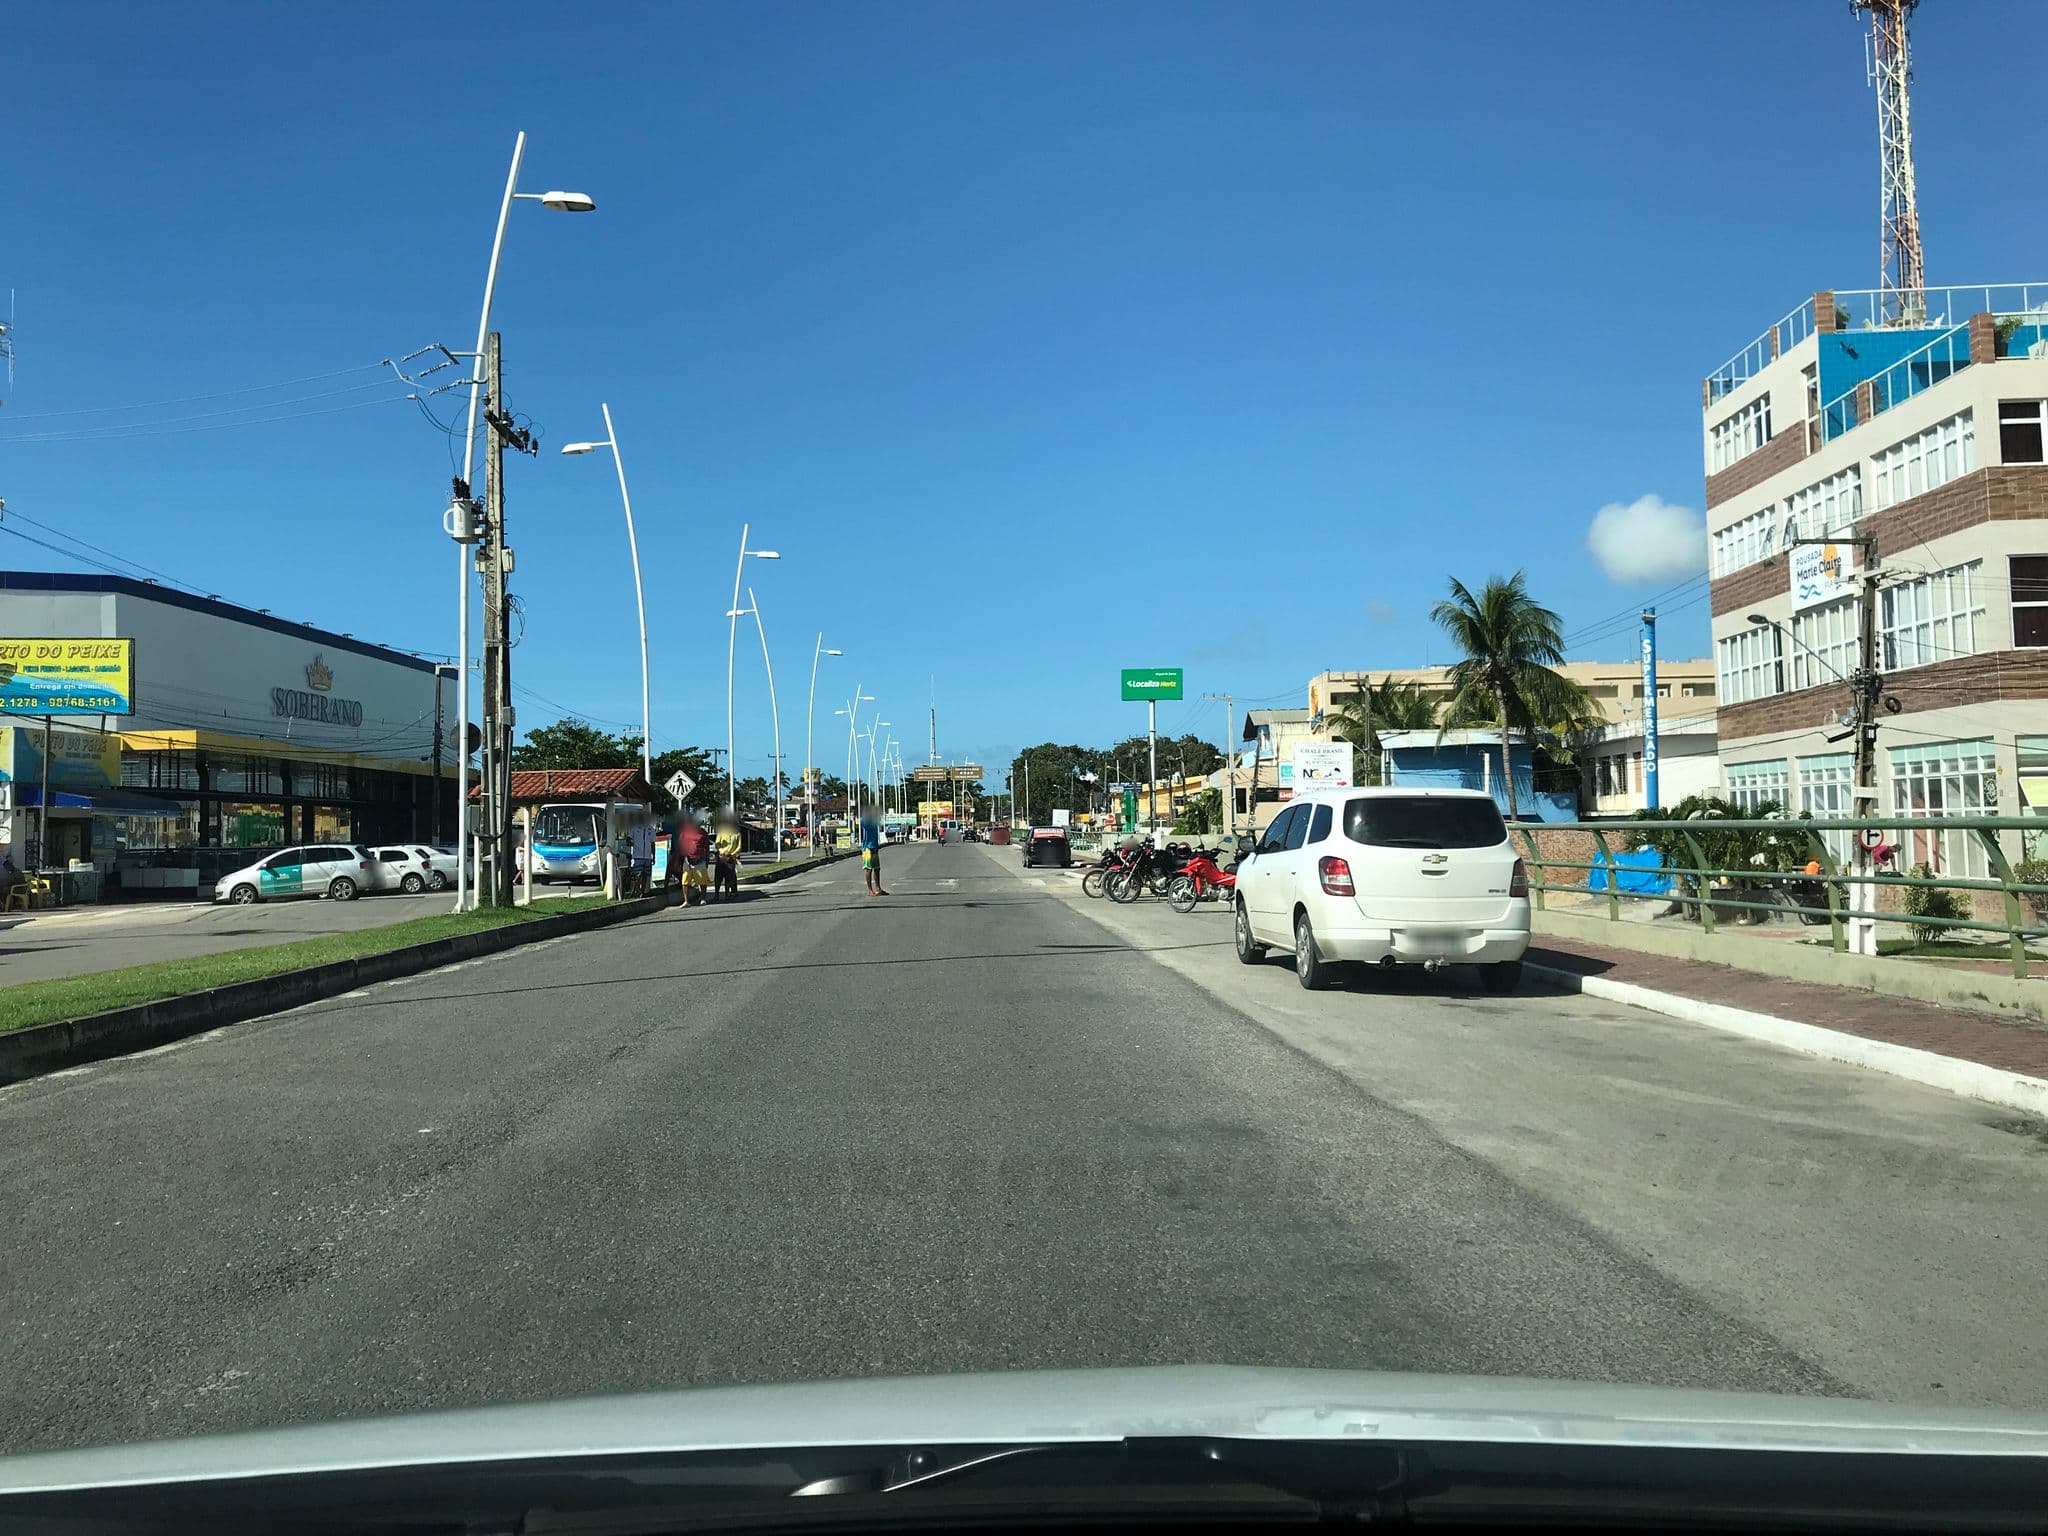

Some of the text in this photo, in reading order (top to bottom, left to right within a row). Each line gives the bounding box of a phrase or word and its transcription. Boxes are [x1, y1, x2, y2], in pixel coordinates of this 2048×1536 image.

[1796, 549, 1823, 566] POUSADA
[1797, 556, 1842, 582] Marie Claire
[36, 646, 62, 659] DO
[68, 645, 122, 659] PEIXE
[29, 683, 62, 691] Entrega
[1132, 680, 1160, 689] Localiza
[271, 687, 363, 728] SOBERANO
[1642, 639, 1656, 771] SUPERMERCADO
